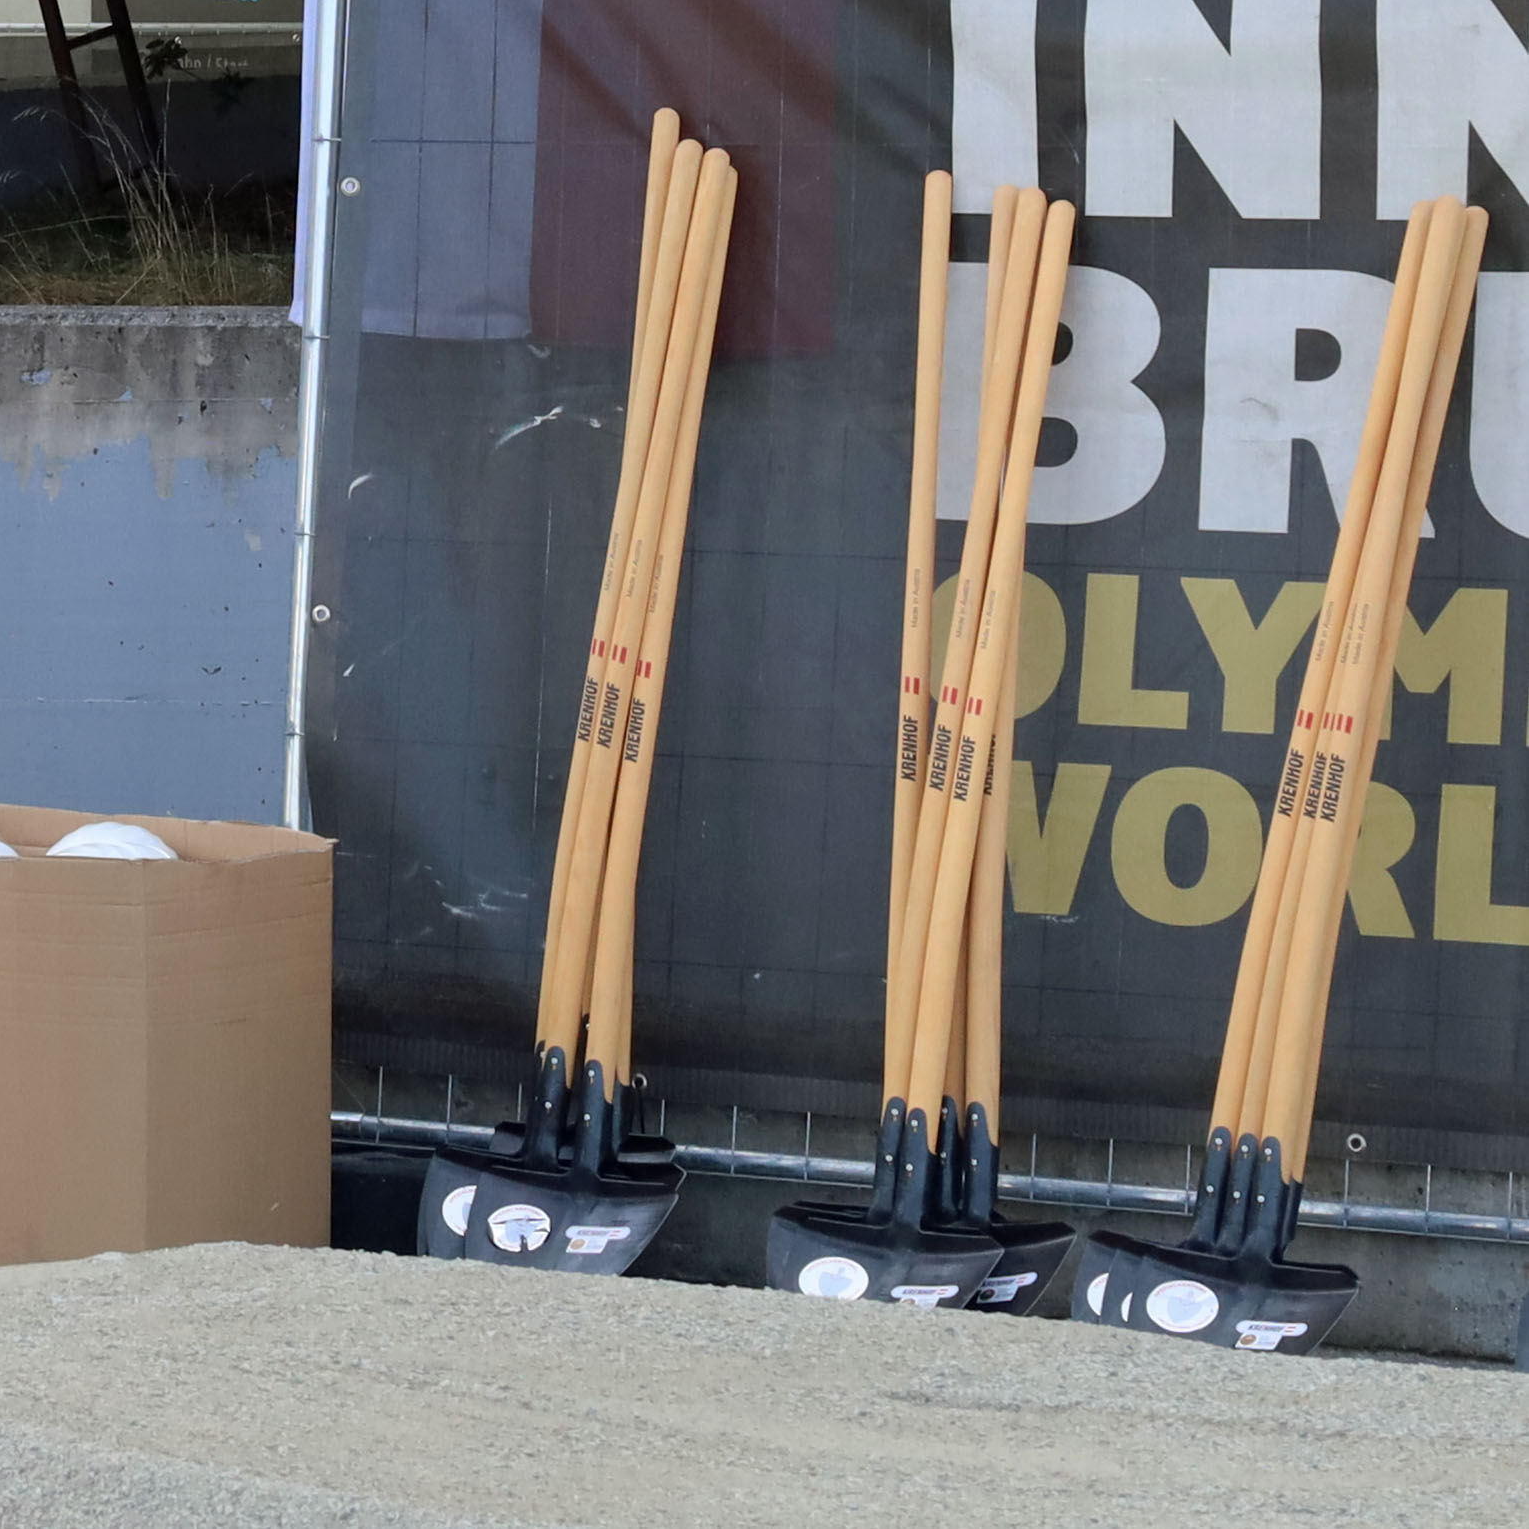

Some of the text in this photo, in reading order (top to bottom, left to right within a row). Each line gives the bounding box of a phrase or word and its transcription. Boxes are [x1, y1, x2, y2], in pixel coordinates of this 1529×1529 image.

[935, 261, 1529, 539] BR
[929, 569, 1529, 746] OLYM
[577, 676, 599, 742] KRENHOF
[596, 681, 621, 749] KRENHOF
[624, 697, 646, 763] KRENHOF
[900, 715, 919, 782] KRENHOF
[929, 724, 952, 792] KRENHOF
[953, 735, 976, 802] KRENHOF
[1278, 748, 1305, 818] KRENHOF
[1303, 751, 1328, 820] KRENHOF
[1319, 753, 1346, 823] KRENHOF
